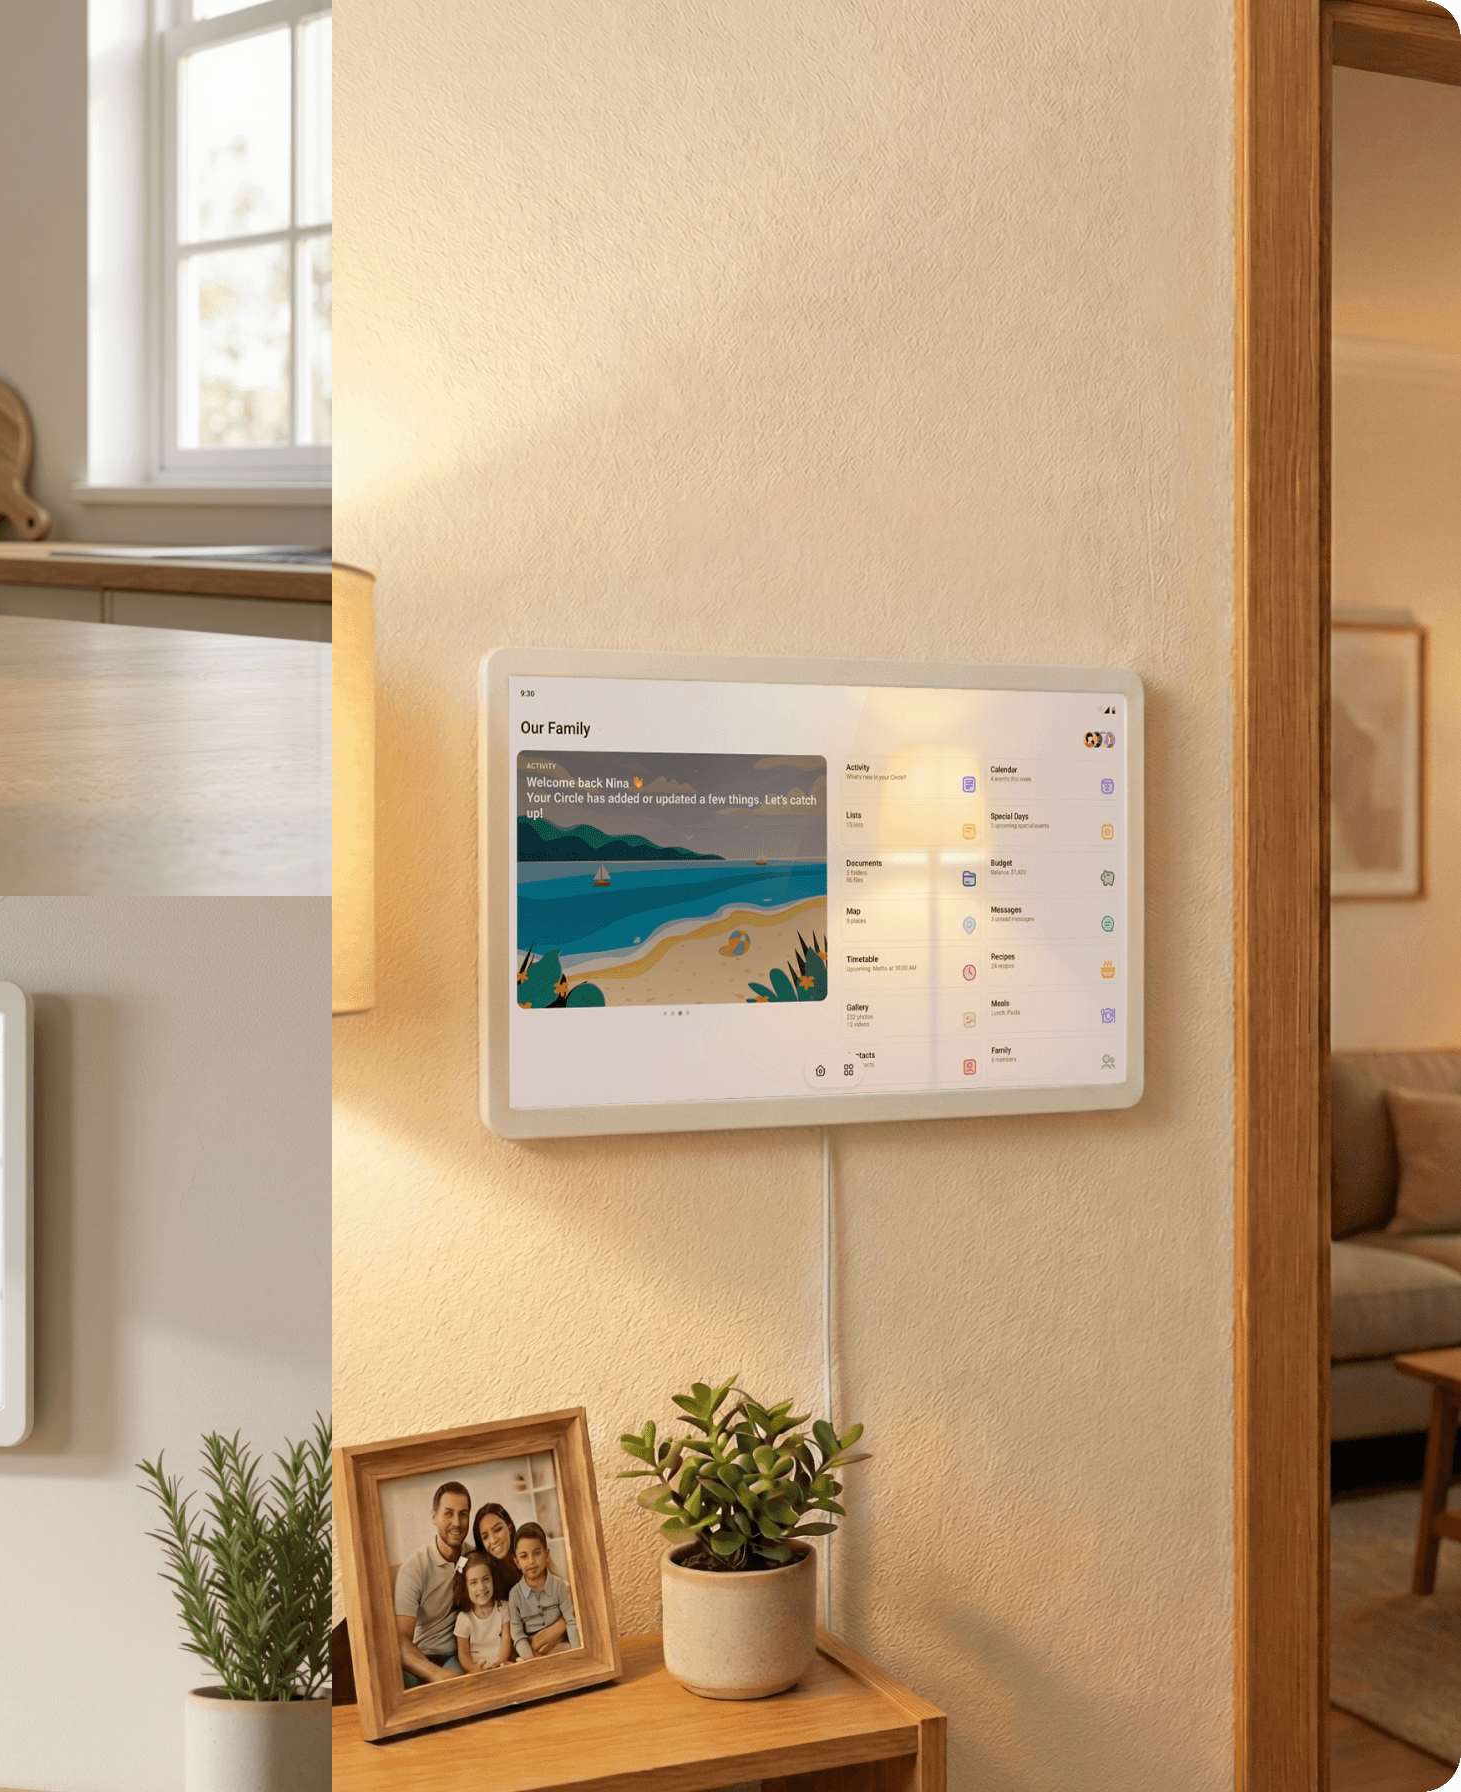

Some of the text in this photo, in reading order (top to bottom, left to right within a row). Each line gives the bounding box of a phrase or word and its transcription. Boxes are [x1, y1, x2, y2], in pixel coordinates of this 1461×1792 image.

[521, 721, 591, 738] Our Family
[846, 764, 870, 772] Activity
[527, 777, 629, 788] Welcome back Nina
[527, 793, 551, 803] Your
[554, 793, 584, 804] Circle
[587, 793, 605, 804] has
[608, 794, 639, 804] added
[643, 796, 652, 804] or
[656, 794, 697, 807] updated
[708, 794, 725, 805] few
[728, 794, 762, 807] things.
[790, 795, 816, 805] catch
[527, 809, 542, 820] up!
[991, 813, 1028, 821] Special Days
[991, 860, 1012, 868] Budget
[846, 908, 861, 916] Map
[991, 953, 1015, 961] Recipes
